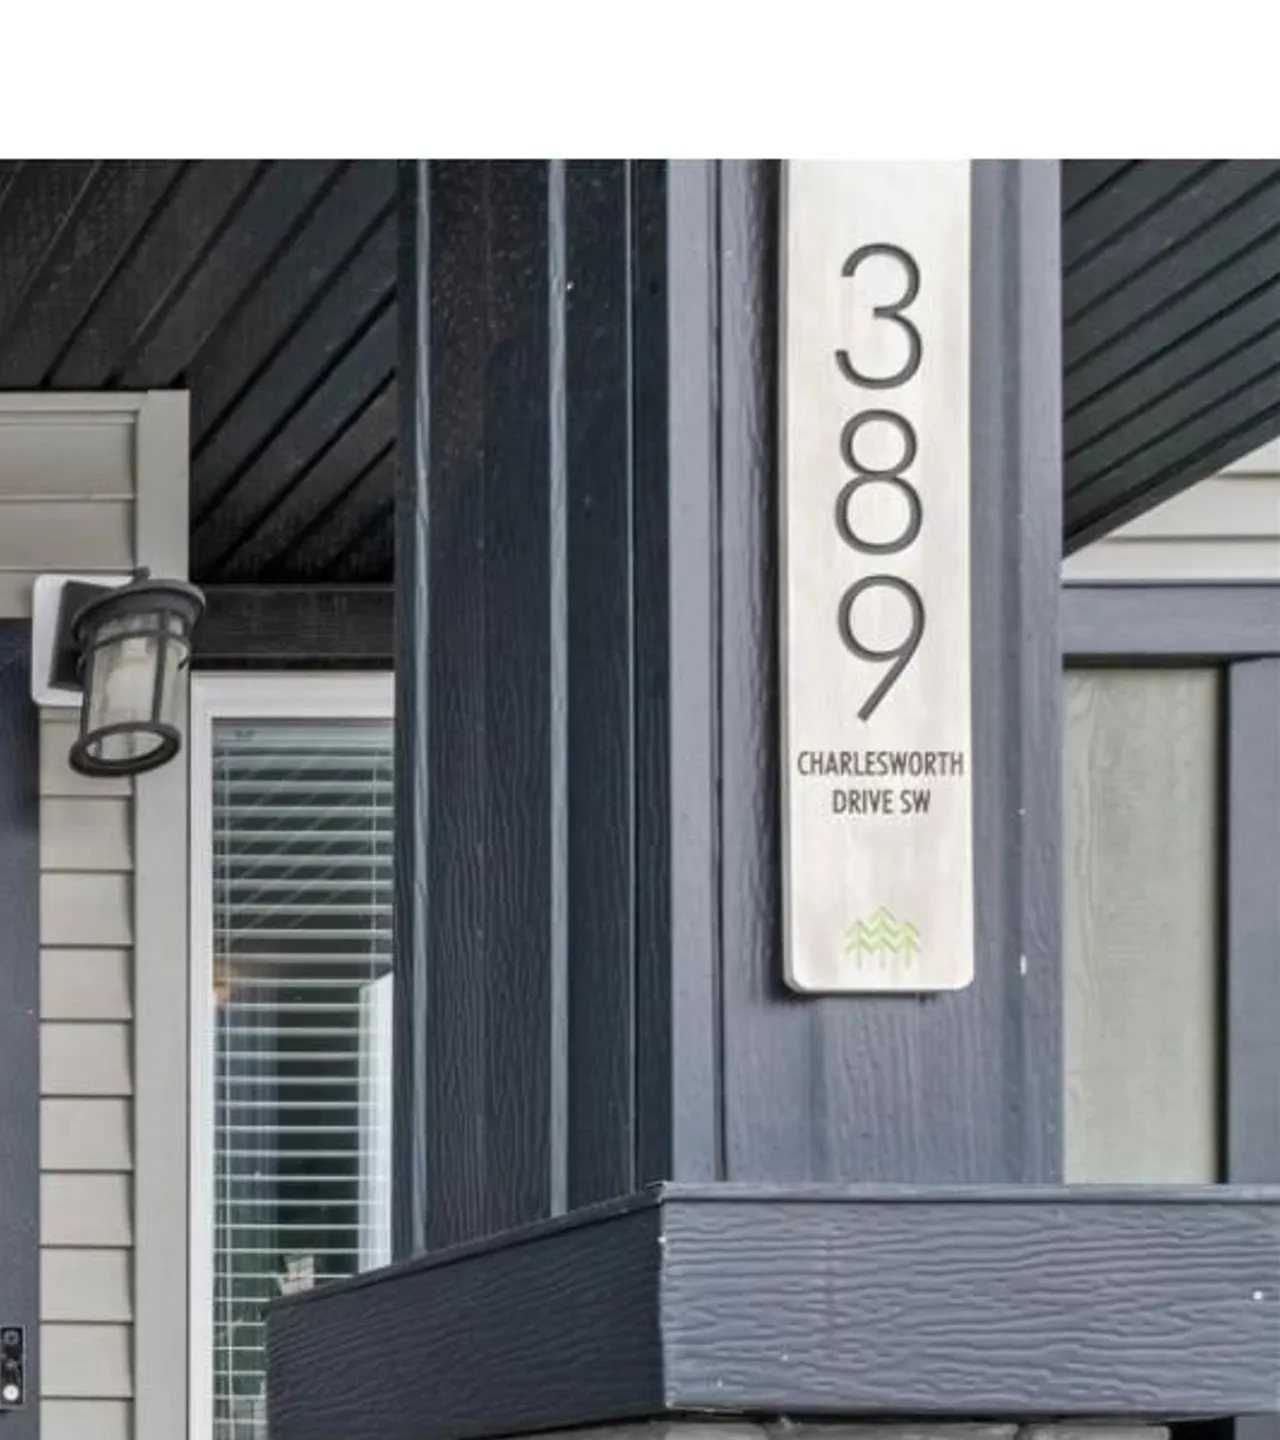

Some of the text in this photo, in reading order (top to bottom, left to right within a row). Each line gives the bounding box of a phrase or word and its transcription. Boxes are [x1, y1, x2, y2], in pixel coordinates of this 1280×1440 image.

[833, 242, 926, 722] 389
[797, 750, 965, 777] CHARLESWORTH
[832, 788, 931, 815] DRIVE SW
